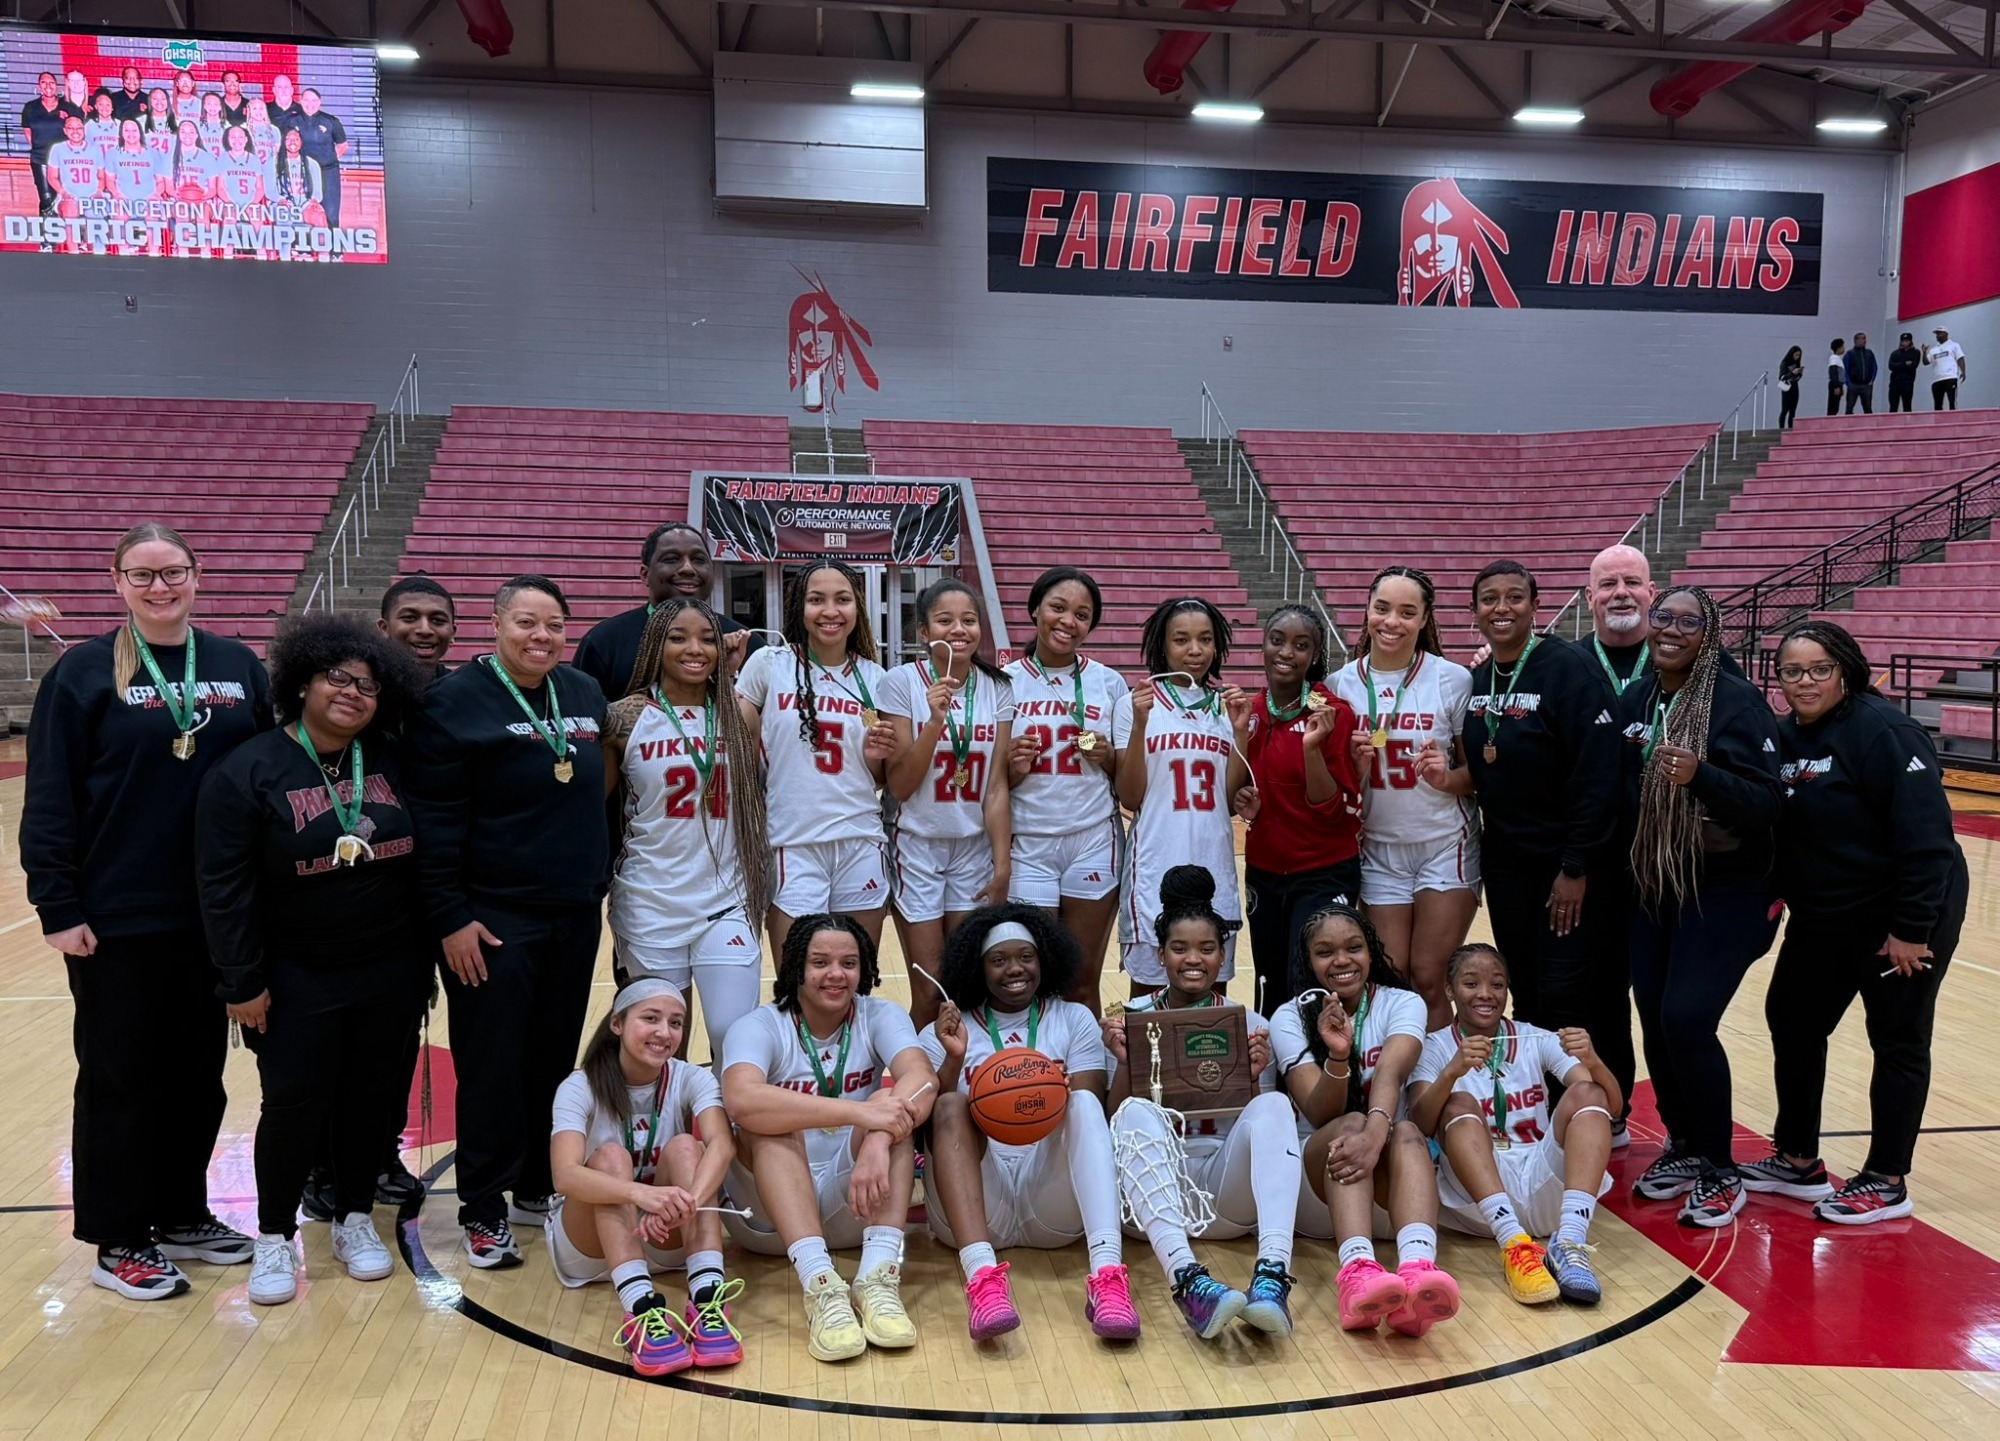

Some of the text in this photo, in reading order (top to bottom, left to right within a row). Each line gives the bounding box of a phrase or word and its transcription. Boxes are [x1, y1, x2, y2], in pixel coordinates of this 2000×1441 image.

[164, 47, 202, 63] OHSAA
[70, 167, 91, 184] 30
[133, 170, 141, 185] 1
[239, 179, 249, 194] 5
[79, 198, 303, 223] PRINCETON VIKINGS
[4, 216, 377, 253] DISTRICT CHAMPIONS
[1019, 187, 1801, 292] FAIRFIELD INDIANS
[725, 480, 940, 505] FAIRFIELD INDIANS
[795, 508, 892, 521] PERFORMANCE
[795, 521, 892, 530] AUTOMOTIVE NETWORK
[827, 533, 845, 547] EXIT
[125, 685, 156, 705] KEEP
[209, 681, 246, 700] THING
[814, 720, 845, 776] 5
[1146, 731, 1231, 757] VIKINGS
[934, 751, 987, 803] 20
[1168, 757, 1216, 812] 13
[993, 1057, 1051, 1084] Rawlings
[1016, 1099, 1044, 1111] OHSAA
